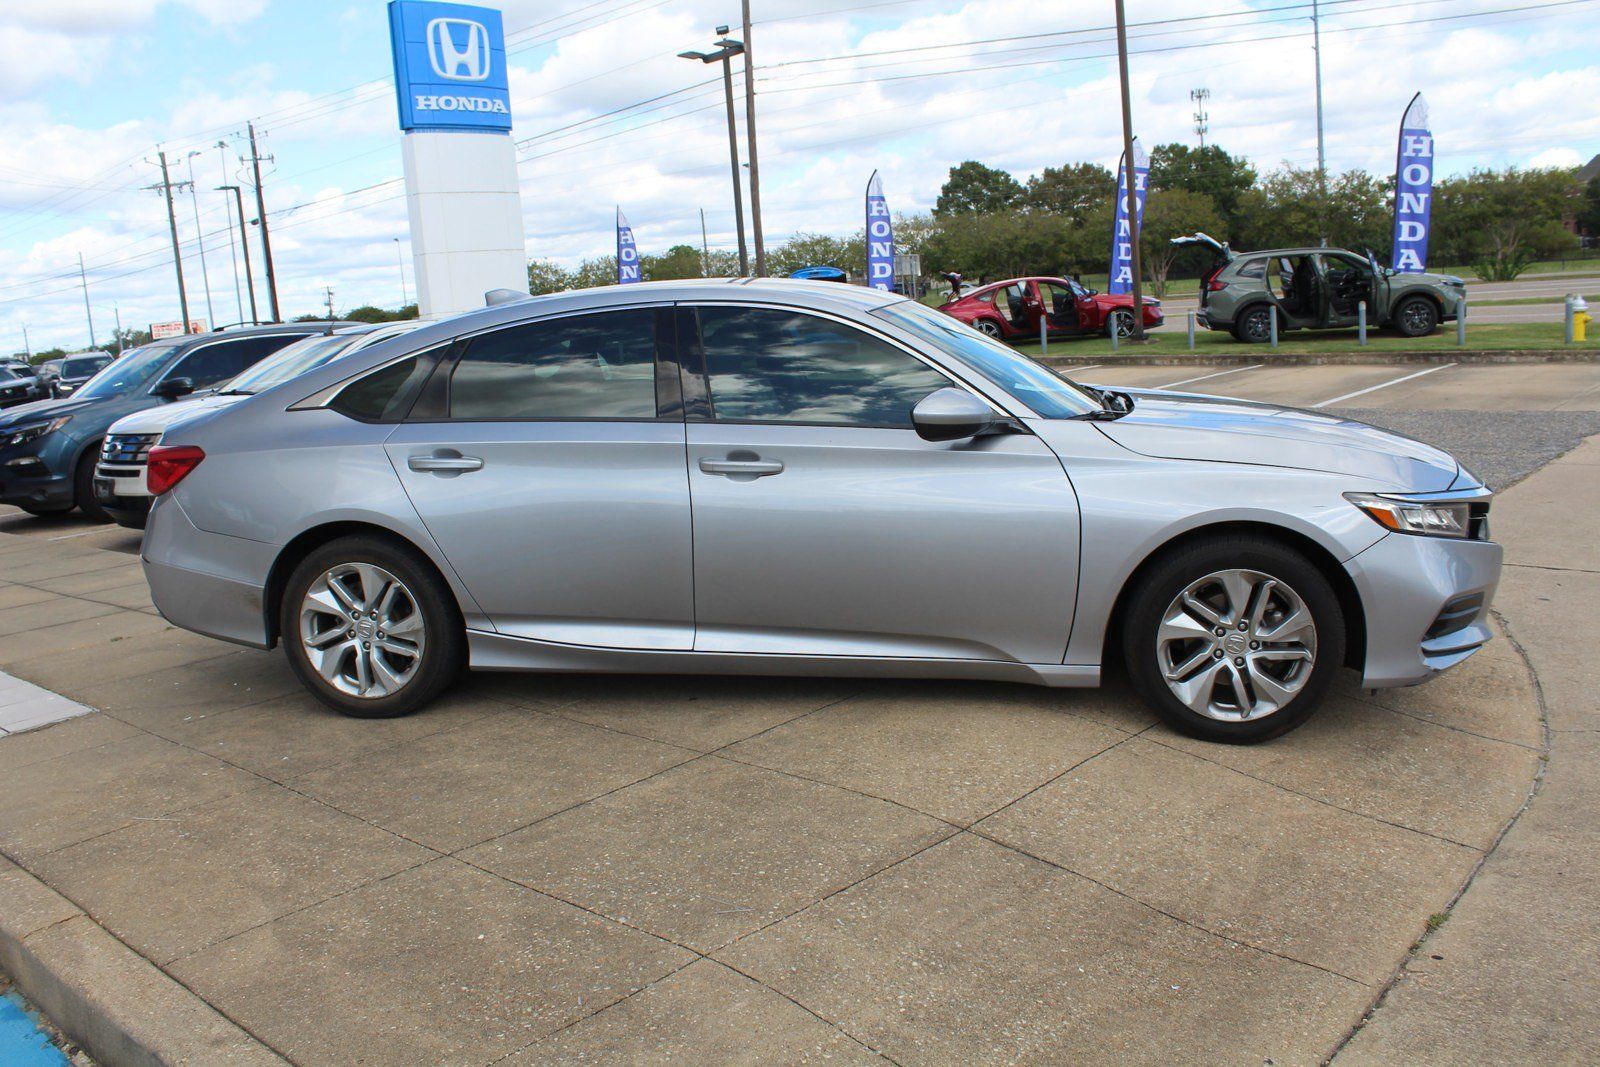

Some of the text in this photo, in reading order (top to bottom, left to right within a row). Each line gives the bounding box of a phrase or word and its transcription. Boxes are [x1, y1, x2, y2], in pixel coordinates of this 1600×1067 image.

[415, 95, 509, 114] HONDA
[1397, 135, 1432, 269] HONDA
[619, 230, 639, 280] HON
